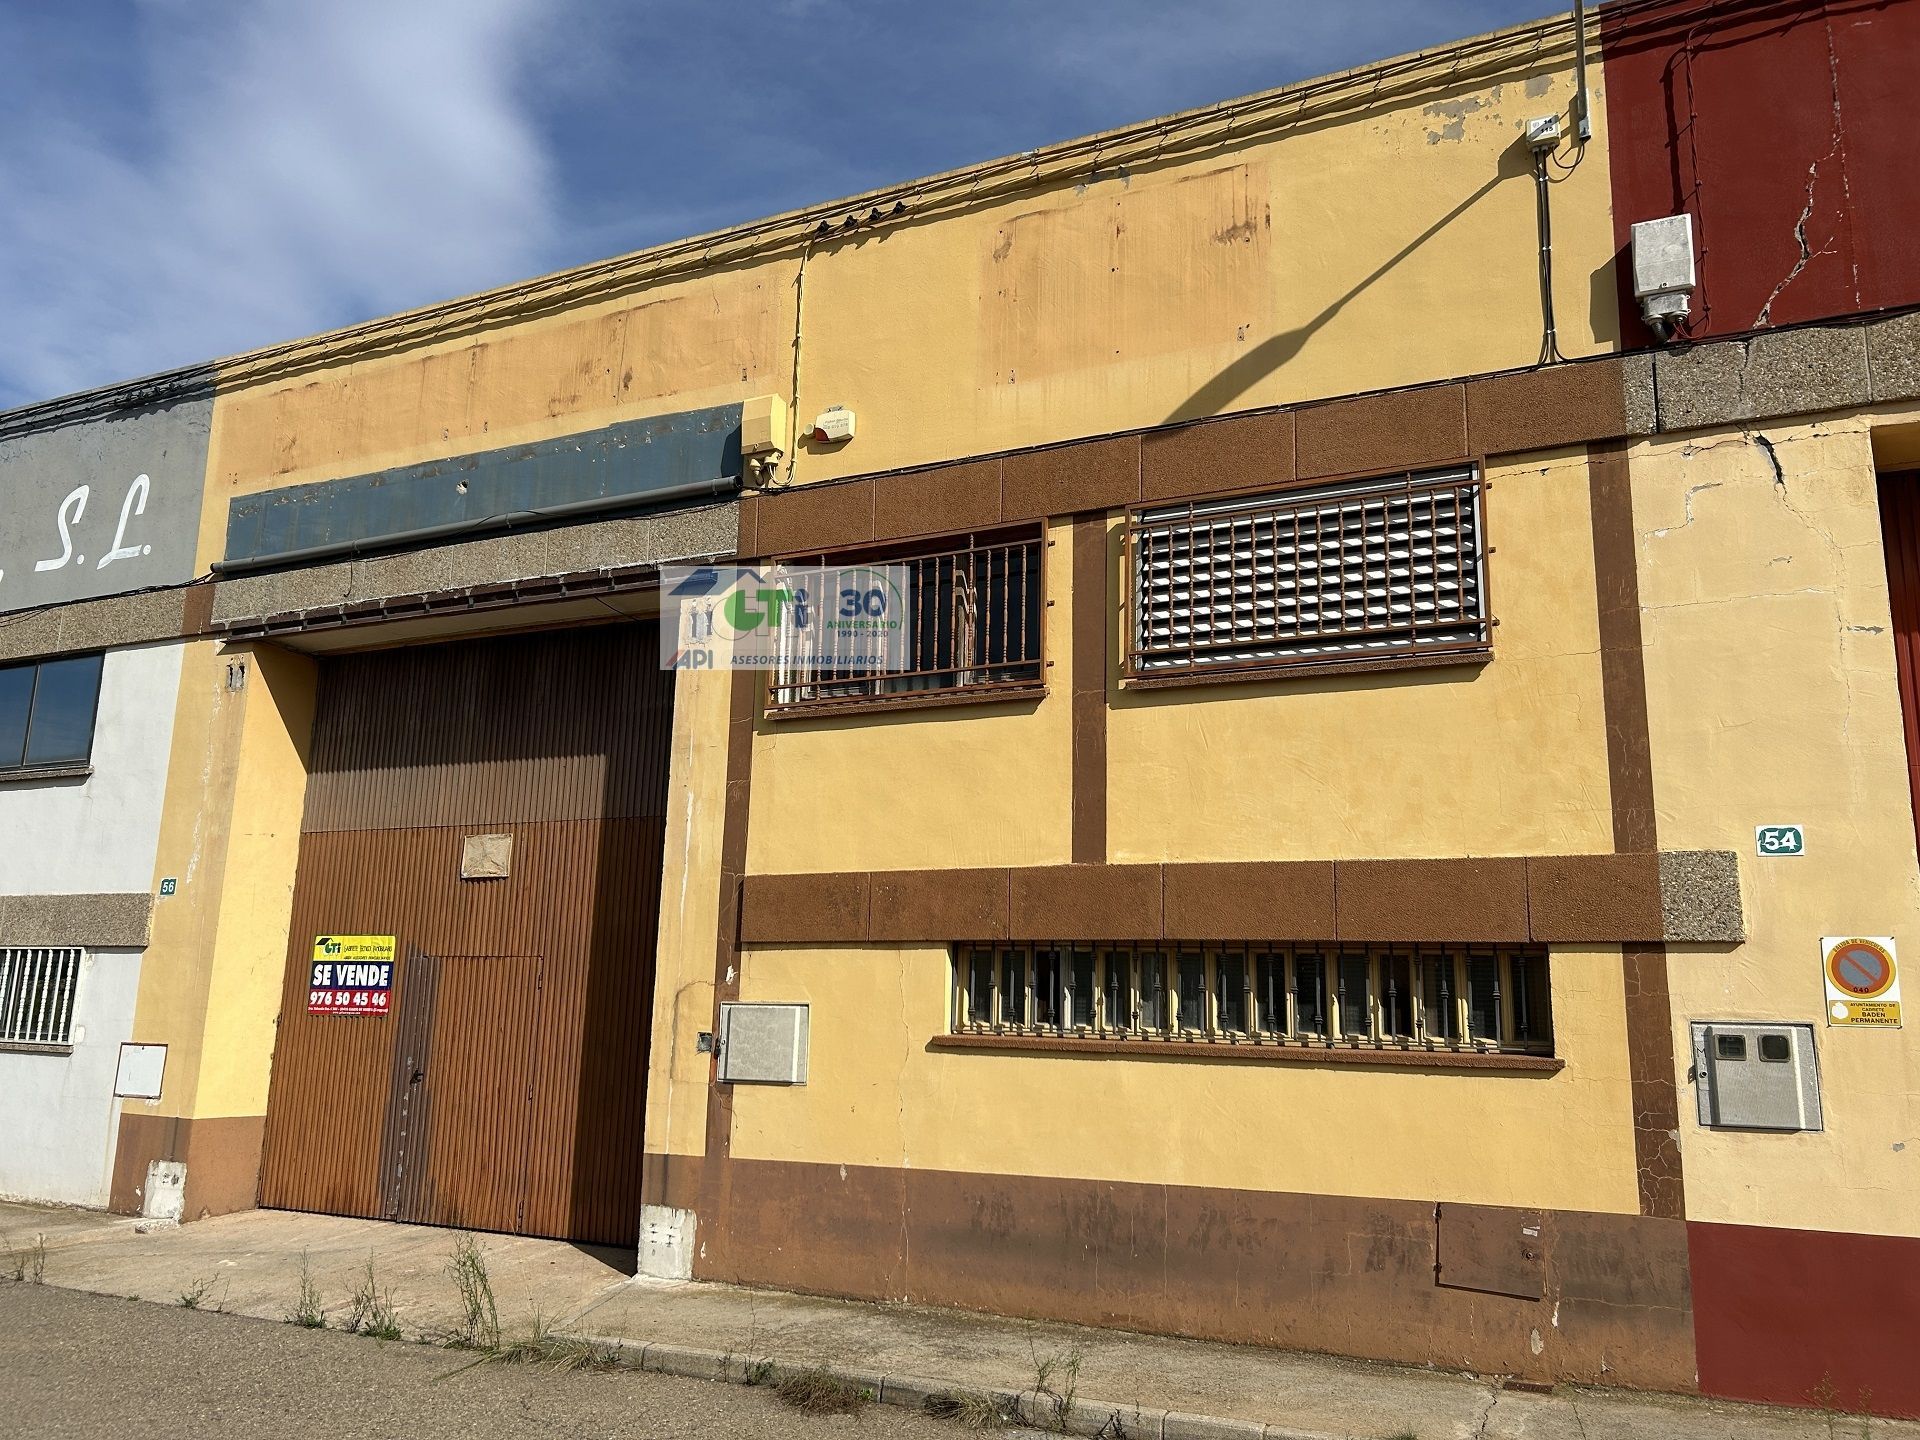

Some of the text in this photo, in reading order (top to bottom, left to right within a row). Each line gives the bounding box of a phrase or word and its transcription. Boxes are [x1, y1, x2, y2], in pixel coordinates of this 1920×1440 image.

[35, 474, 151, 572] S. L.
[1763, 830, 1800, 851] 54
[162, 881, 175, 893] 56
[1832, 939, 1850, 952] SALIDA
[313, 964, 390, 987] SE VENDE
[310, 991, 387, 1007] 976 50 45 46
